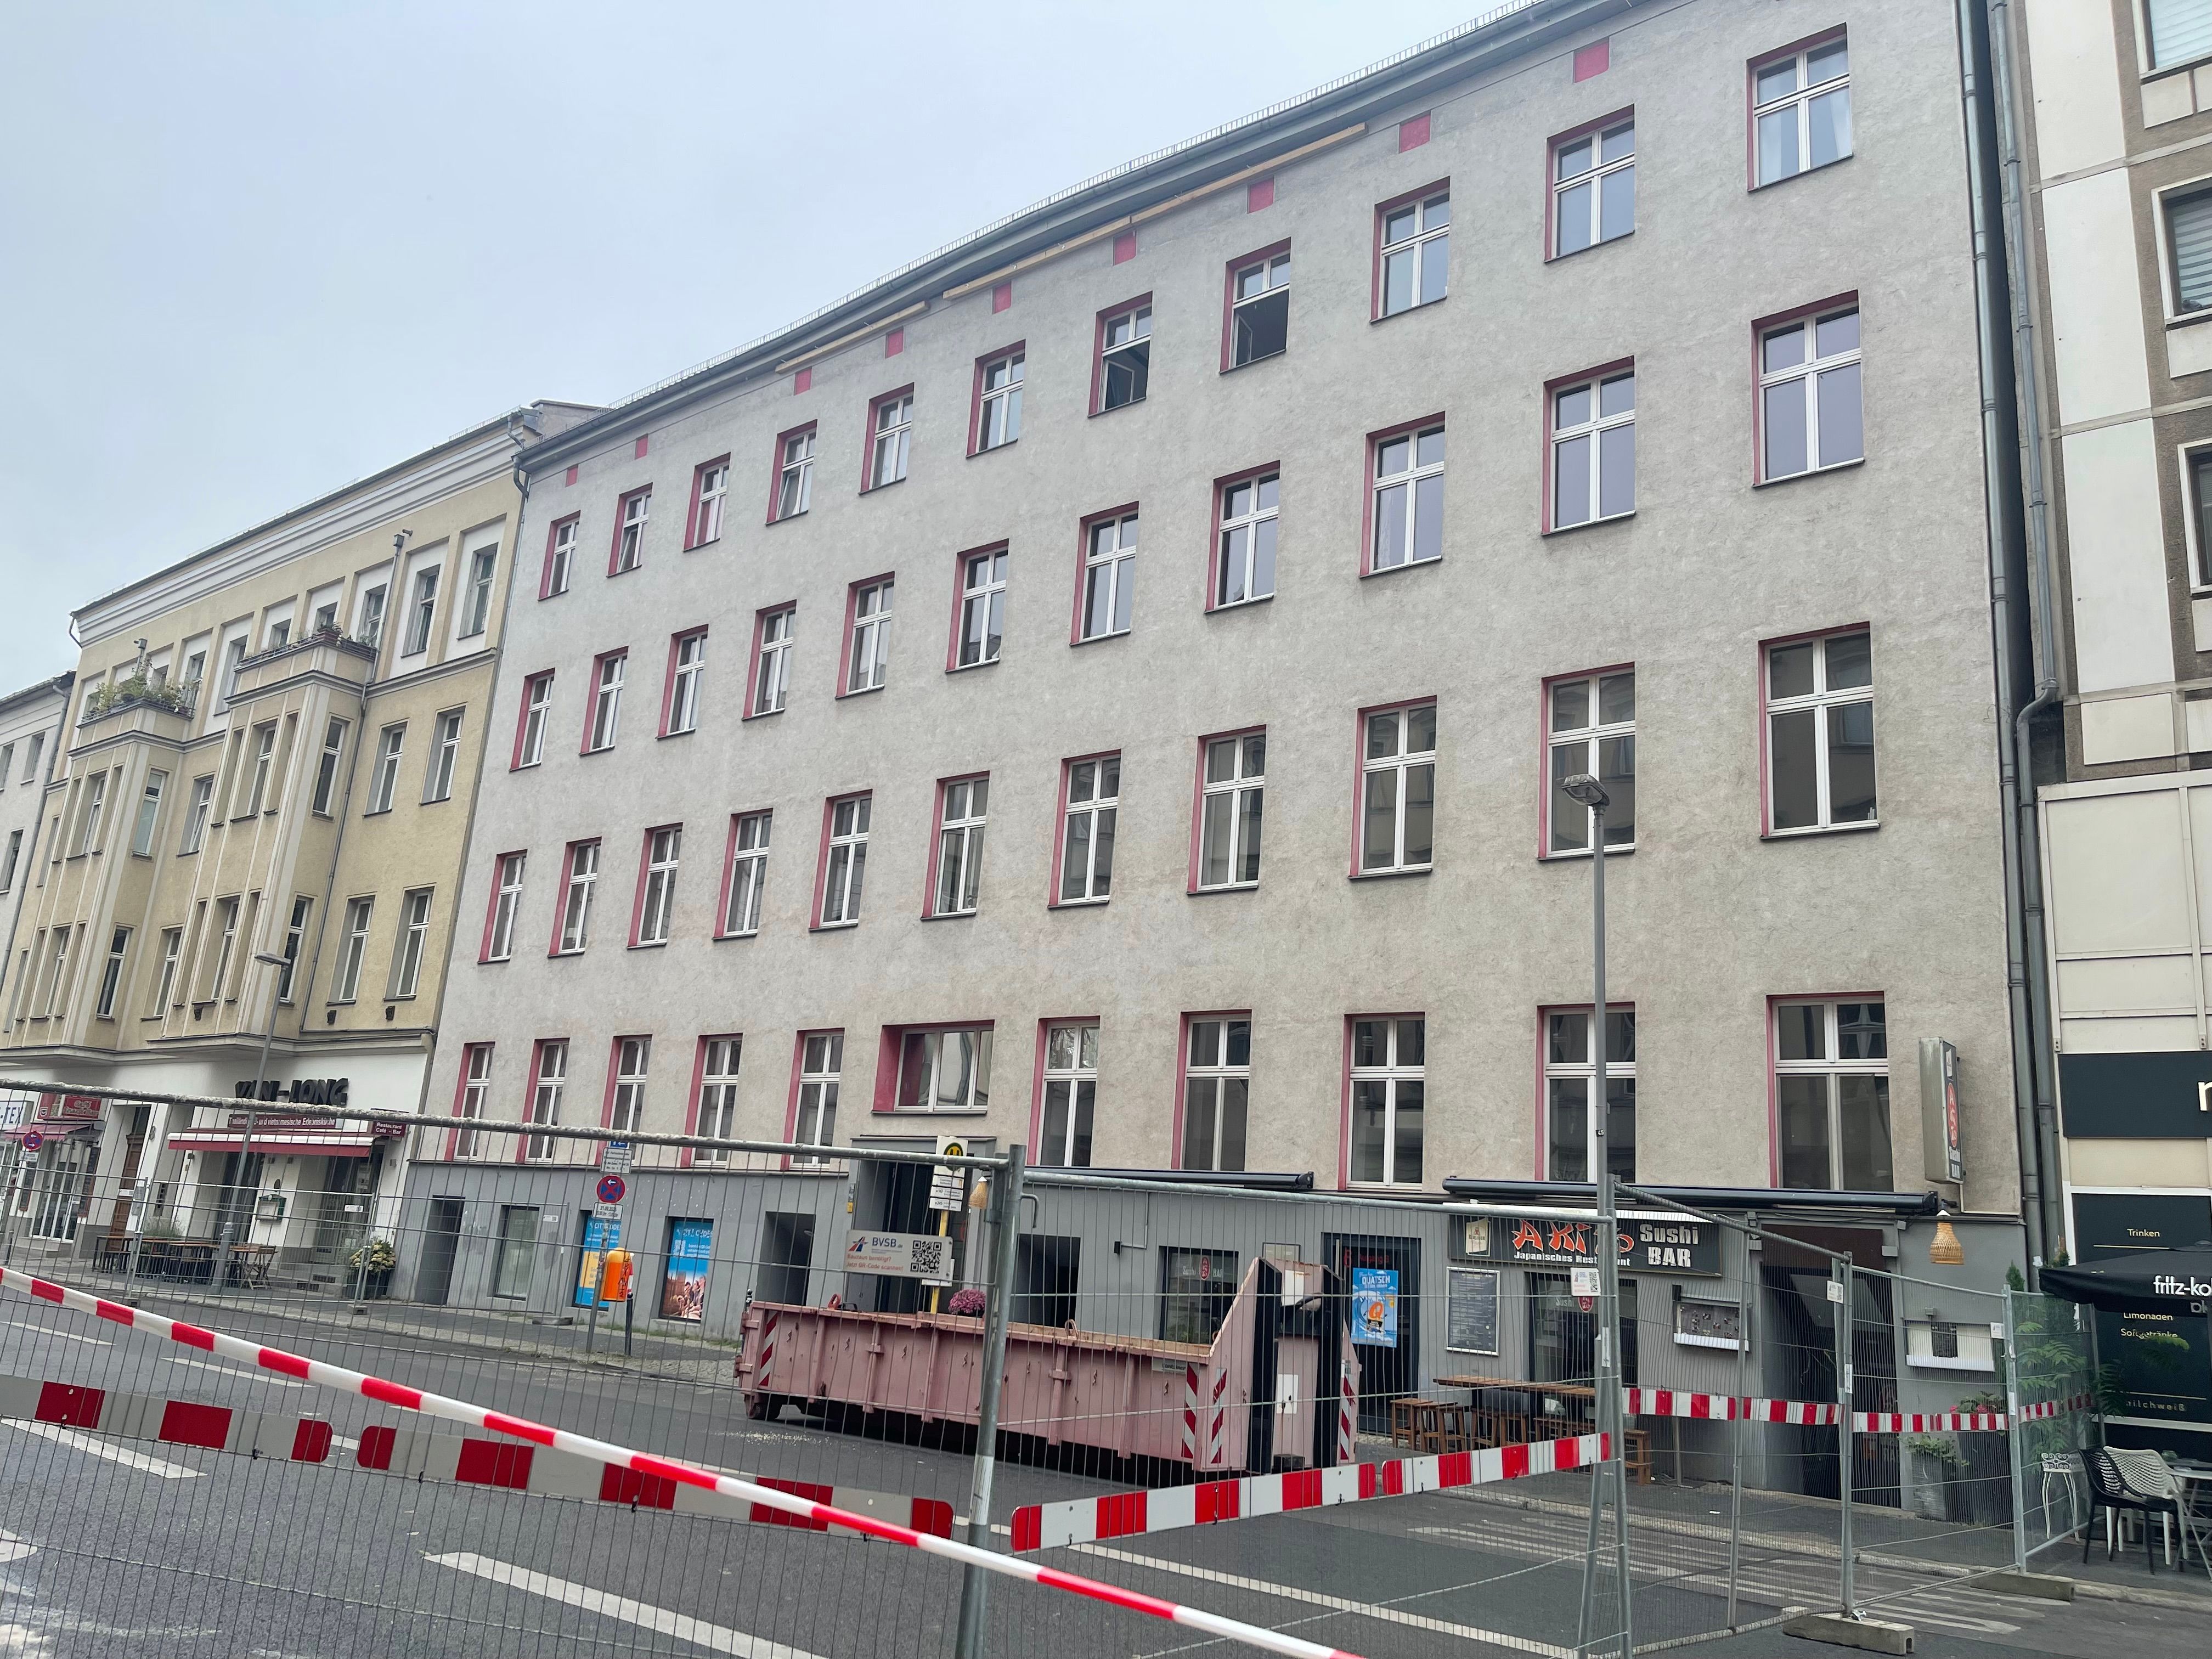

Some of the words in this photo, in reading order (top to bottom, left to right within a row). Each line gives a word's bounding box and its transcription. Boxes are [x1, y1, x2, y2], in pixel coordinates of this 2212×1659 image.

[0, 1107, 23, 1124] -TEX
[1639, 1223, 1699, 1245] Sushi
[2126, 1228, 2160, 1238] Trinken
[1514, 1251, 1573, 1262] Japanisches
[1576, 1255, 1631, 1267] Restnt
[1647, 1246, 1691, 1267] BAR
[1362, 1275, 1391, 1285] QUATSCH
[1556, 1296, 1575, 1307] Sushi
